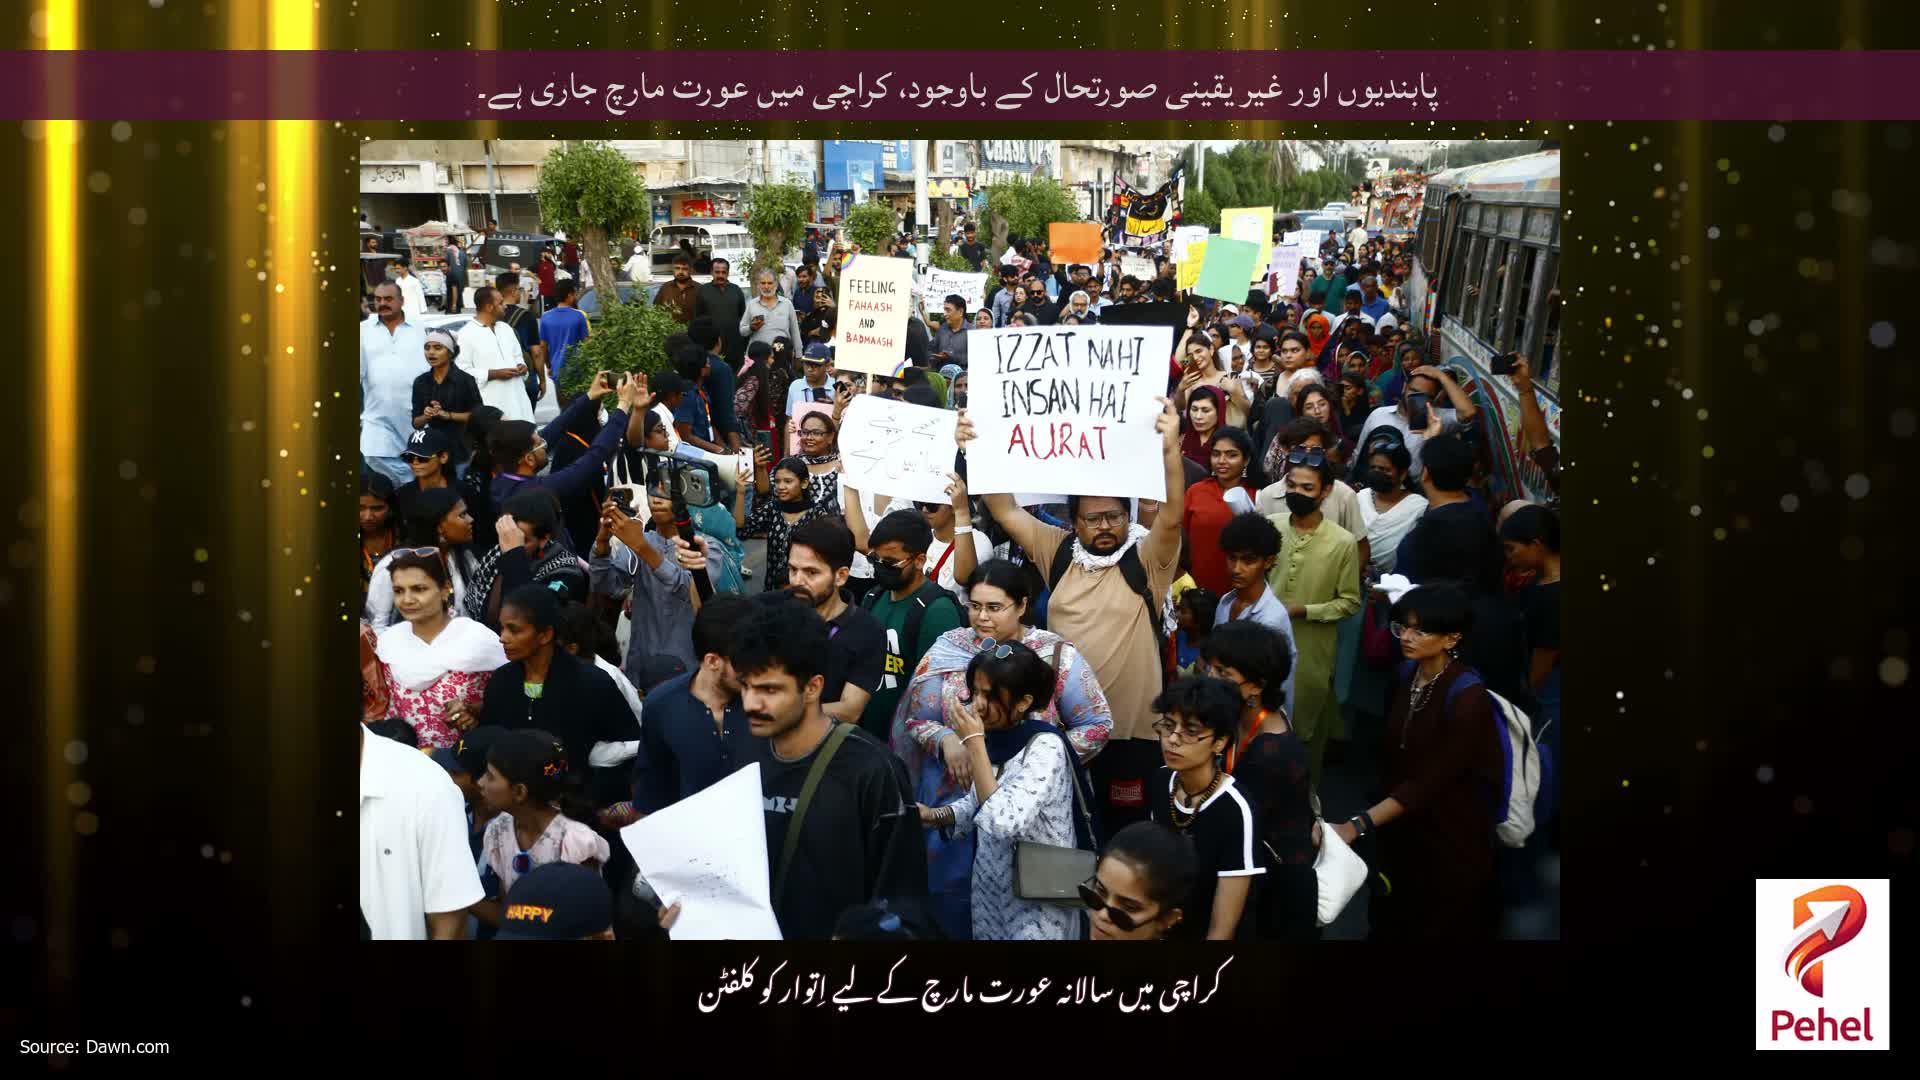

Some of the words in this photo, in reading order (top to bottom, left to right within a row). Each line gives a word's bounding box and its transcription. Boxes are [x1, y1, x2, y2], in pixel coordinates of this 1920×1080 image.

[849, 279, 896, 294] FEELING
[848, 299, 893, 313] FAHAASH
[858, 318, 875, 329] AND
[845, 332, 893, 348] BADMAASH
[993, 331, 1077, 375] IZZAT
[1087, 336, 1145, 376] NAHI
[1001, 377, 1081, 418] INSAN
[1088, 380, 1132, 424] HAI
[1007, 422, 1108, 460] AURAT
[505, 904, 555, 924] HAPPY
